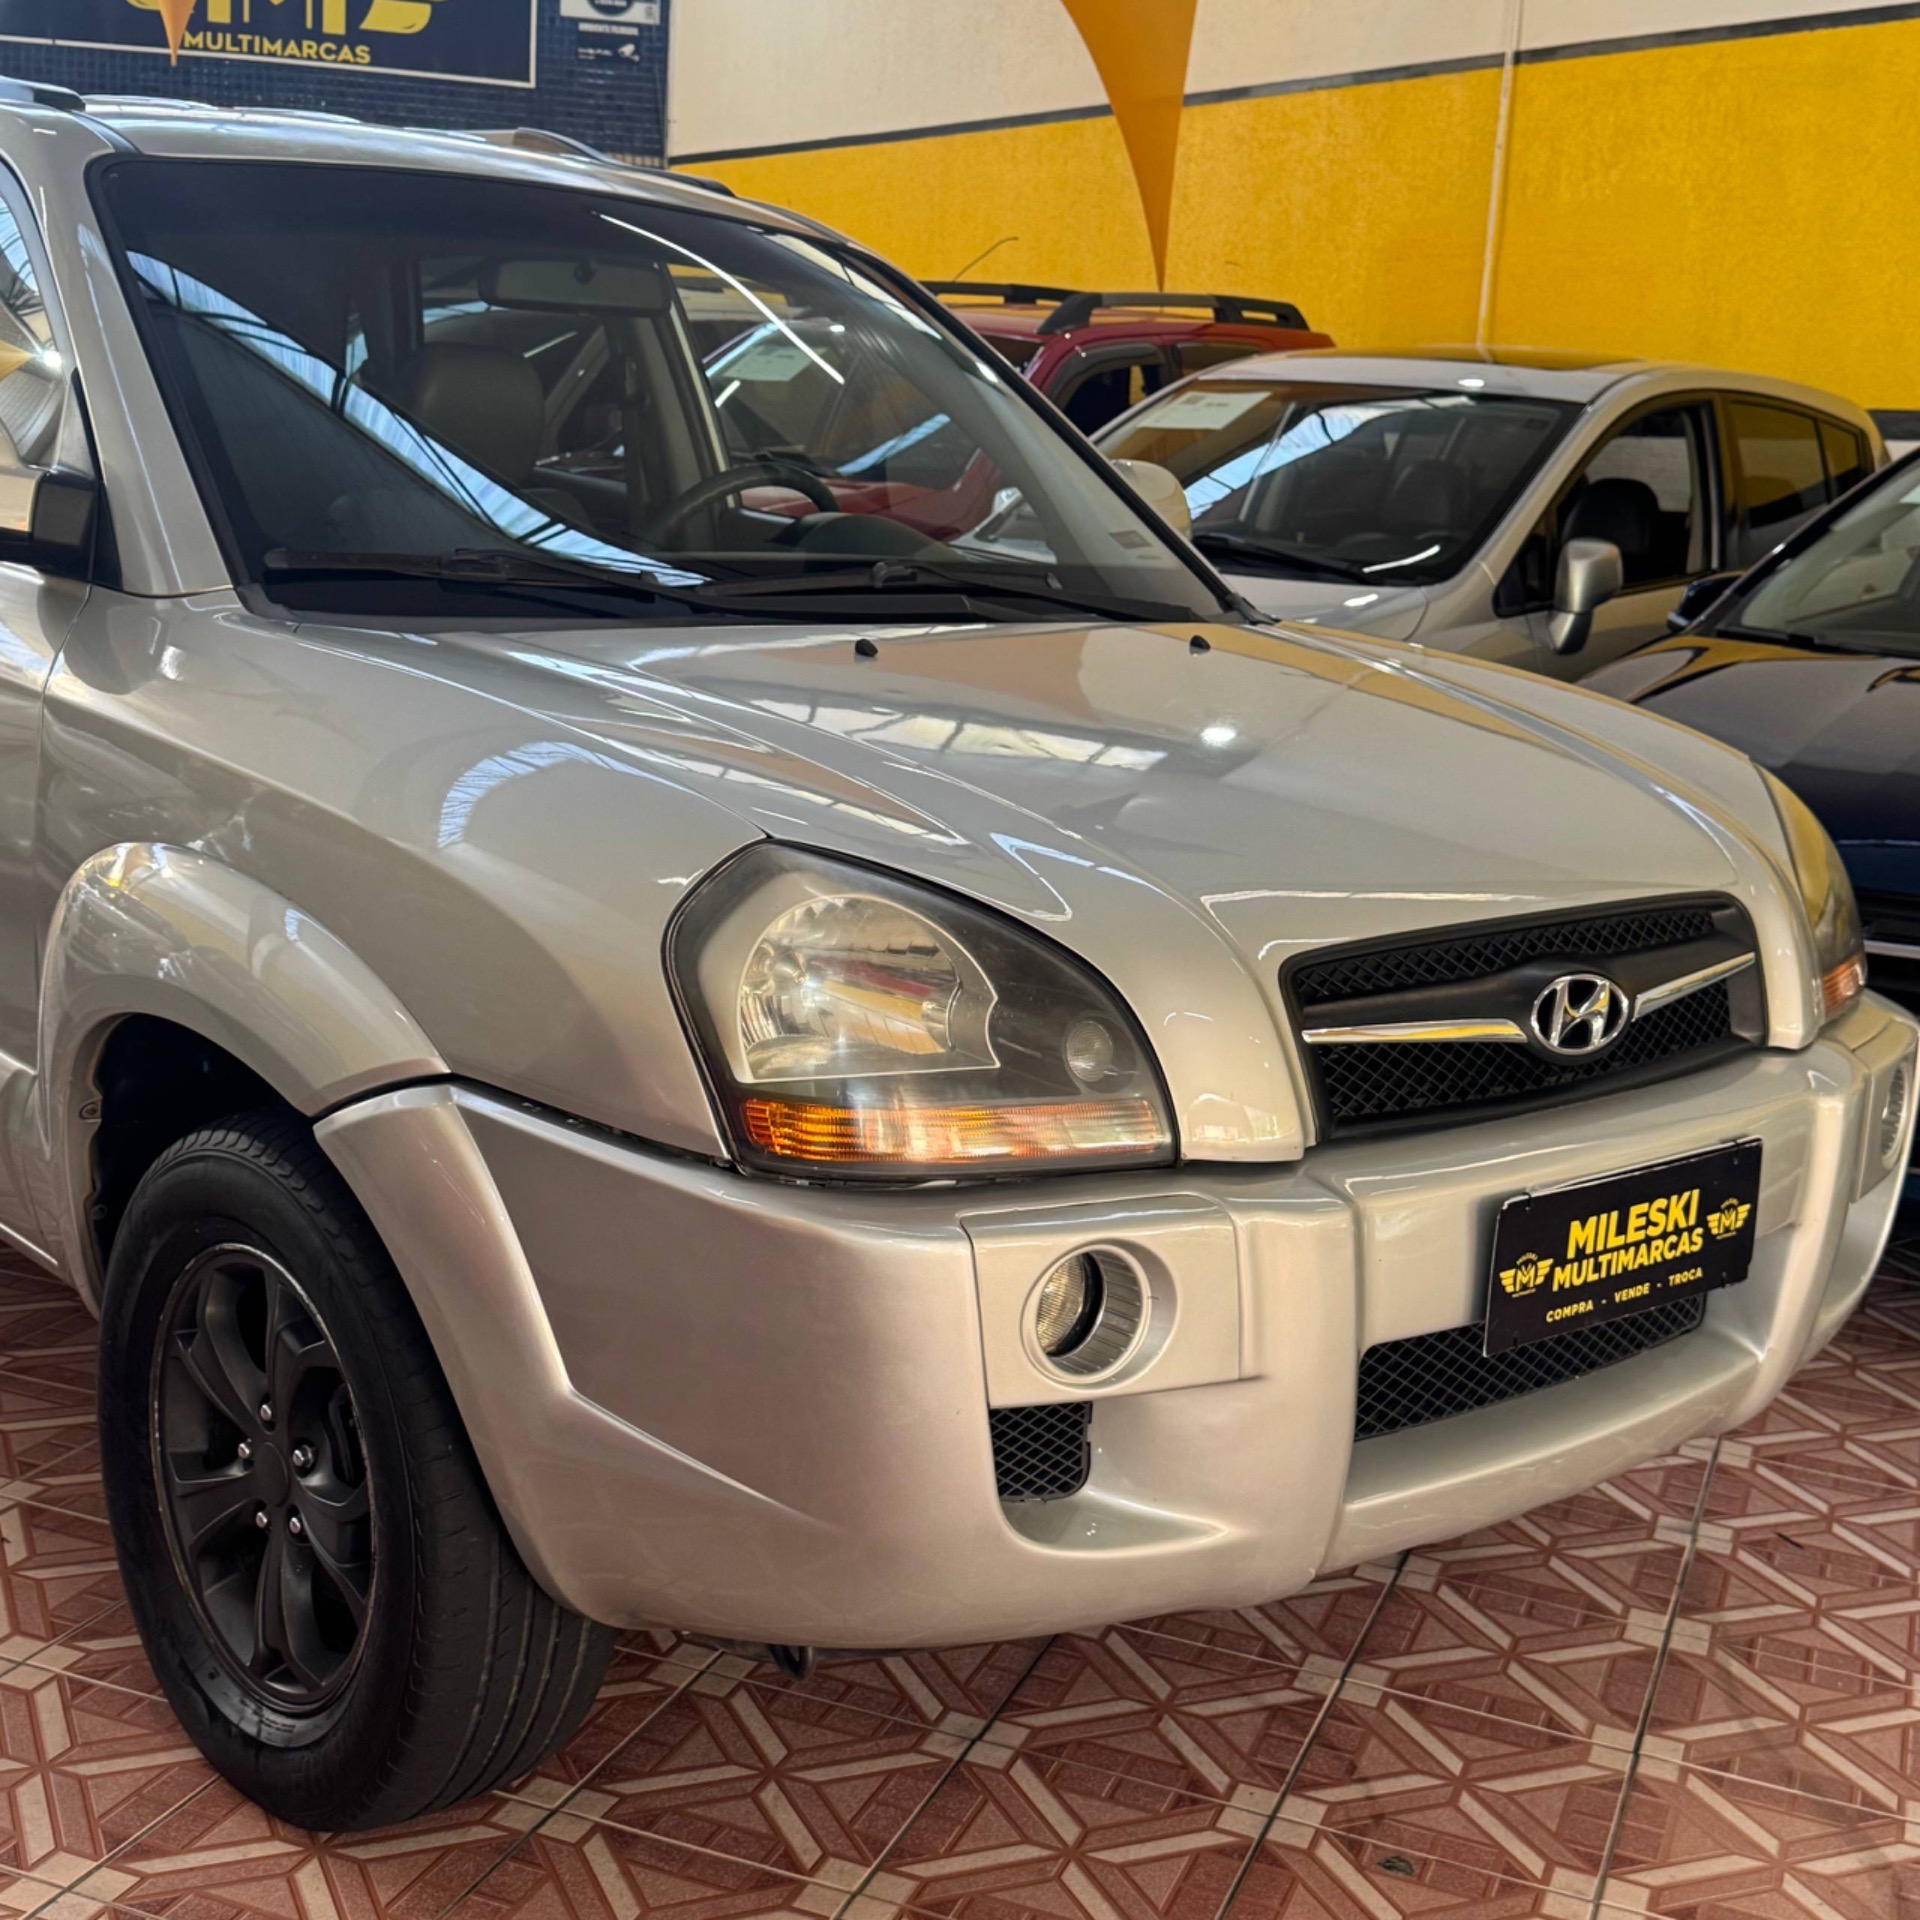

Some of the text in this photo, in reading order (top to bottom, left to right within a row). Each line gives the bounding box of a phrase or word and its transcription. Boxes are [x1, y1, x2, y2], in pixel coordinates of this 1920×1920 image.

[183, 31, 371, 64] MULTIMARCAS
[1566, 1188, 1700, 1260] MILESKI
[1551, 1227, 1704, 1292] MULTIMARCAS
[1546, 1299, 1594, 1323] COMPRA
[1614, 1282, 1651, 1303] VENDE
[1668, 1266, 1703, 1287] TROCA
